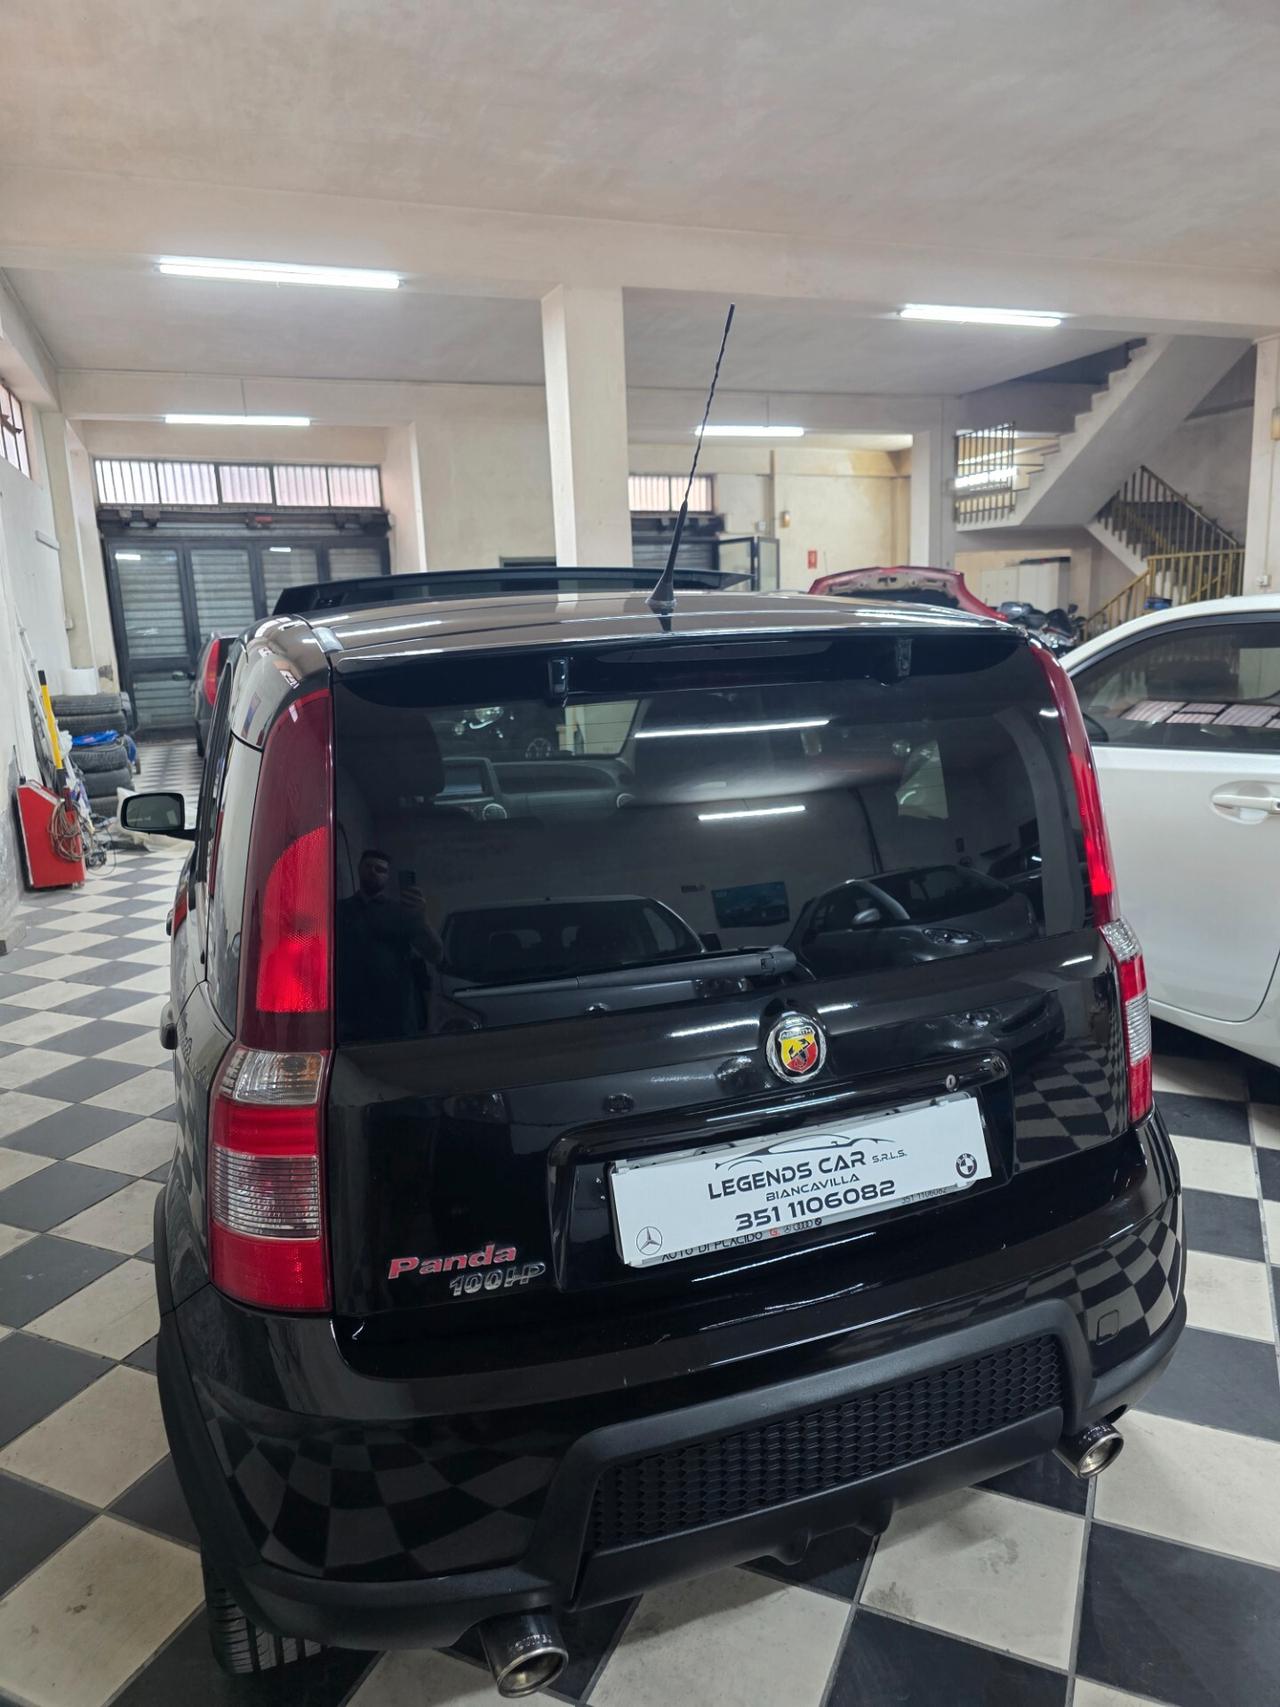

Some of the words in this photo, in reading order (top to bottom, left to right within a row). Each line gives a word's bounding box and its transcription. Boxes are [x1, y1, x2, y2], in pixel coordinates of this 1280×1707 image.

[708, 1162, 812, 1200] LEGENDS
[818, 1150, 866, 1174] CAR
[871, 1149, 908, 1164] S.R.L.S.
[766, 1173, 860, 1202] BIANCAVILLA
[735, 1206, 781, 1232] 351
[787, 1179, 896, 1219] 1106082
[714, 1231, 763, 1249] PLACIDO
[388, 1243, 517, 1280] Panda
[449, 1261, 546, 1297] 100HP
